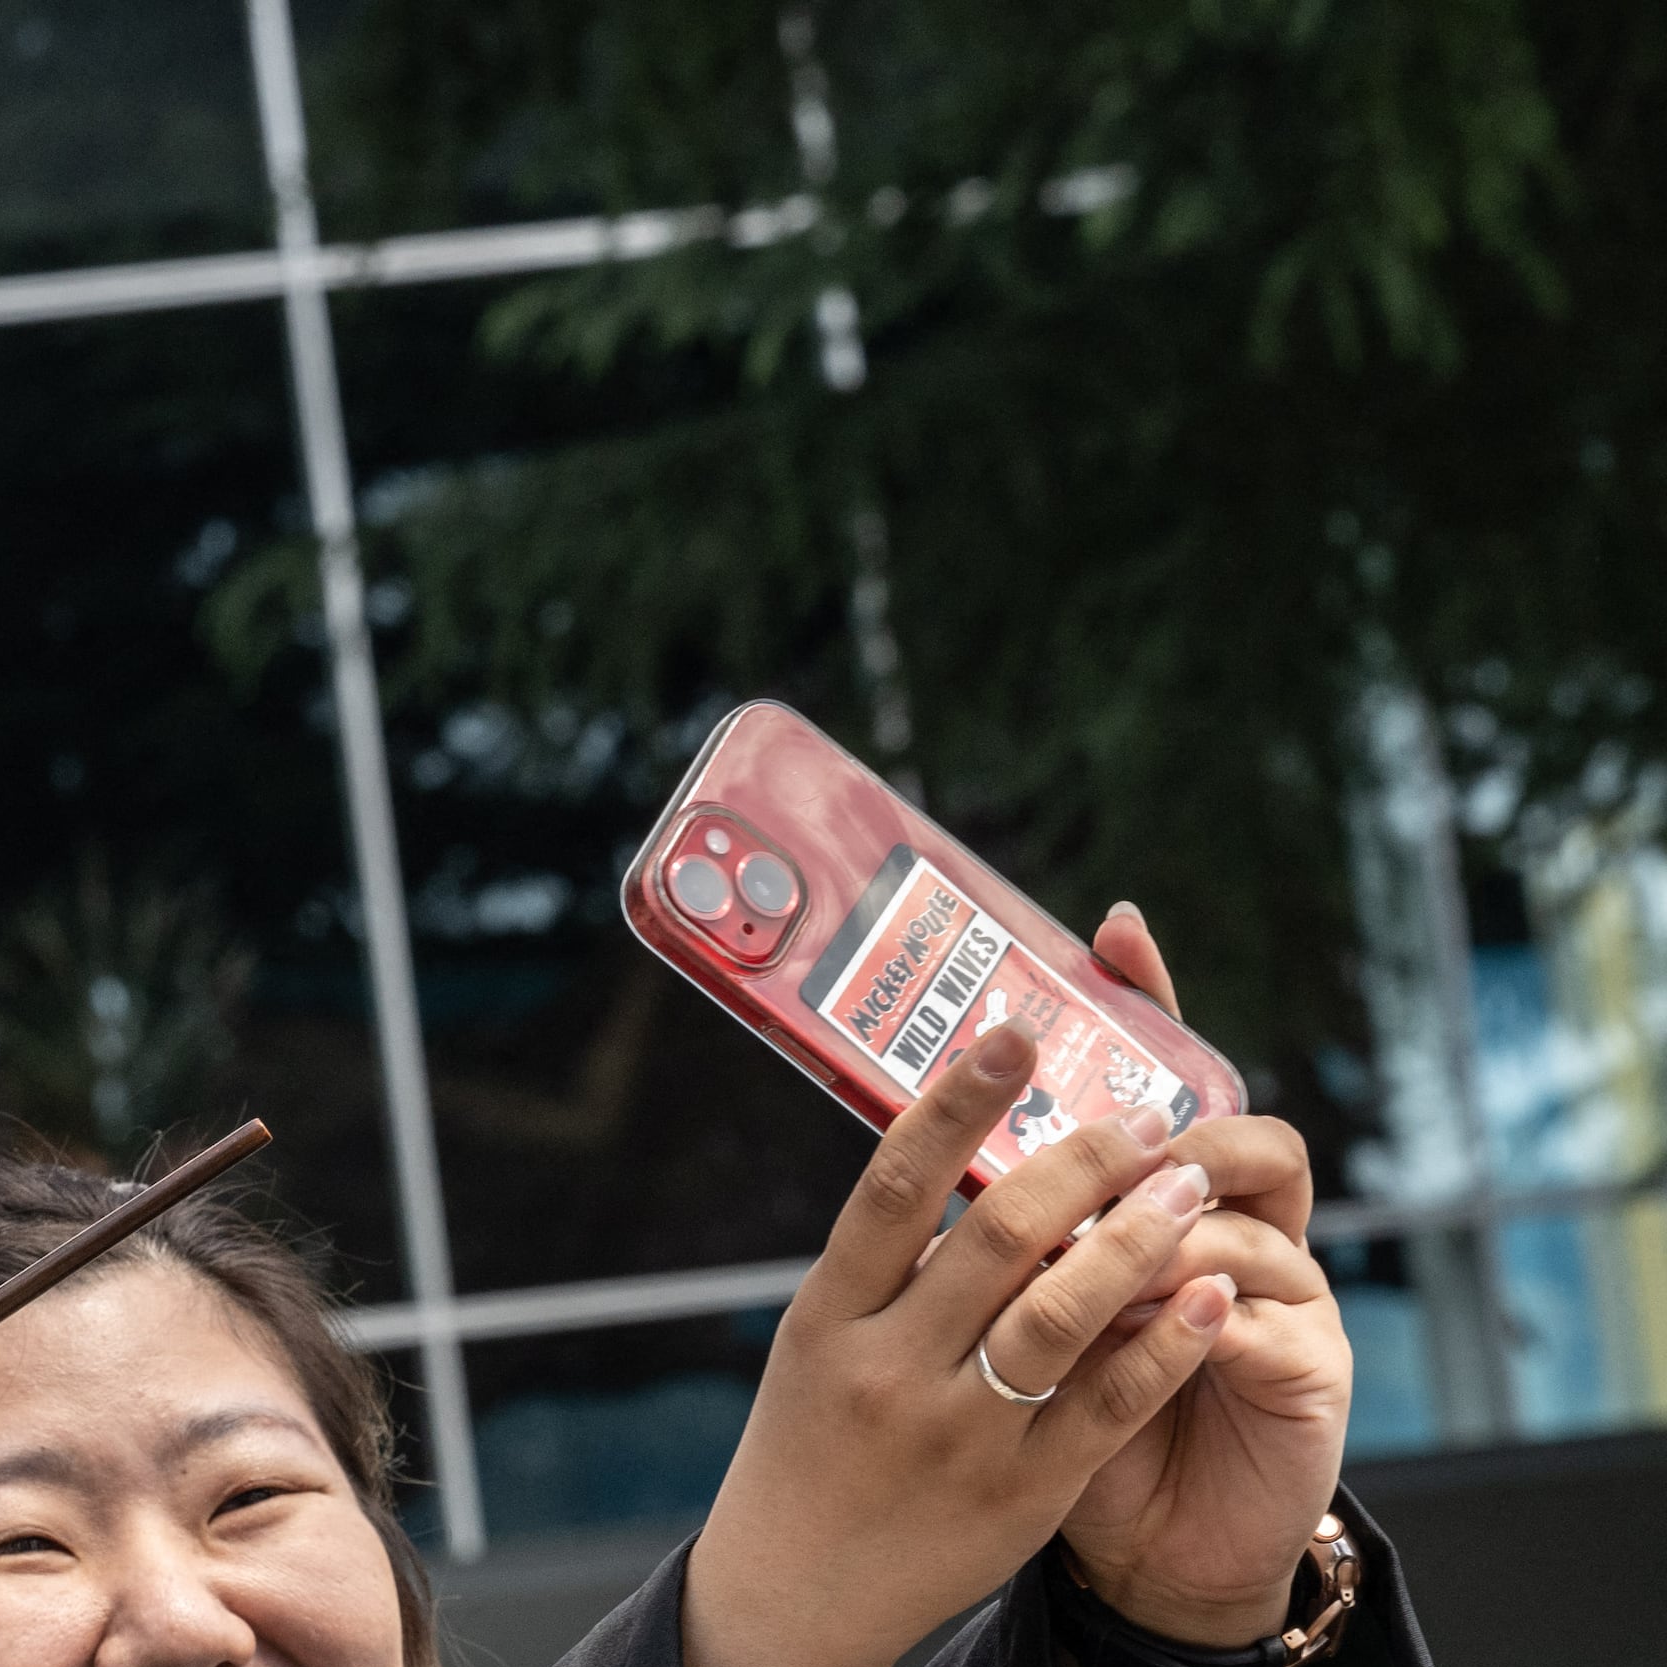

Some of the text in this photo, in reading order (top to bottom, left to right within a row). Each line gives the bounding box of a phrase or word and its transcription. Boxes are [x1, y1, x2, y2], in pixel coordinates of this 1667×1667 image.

[845, 953, 916, 1043] MICKEY
[896, 886, 959, 965] MOUSE
[891, 1005, 948, 1071] WILD
[934, 927, 999, 1008] WAVES
